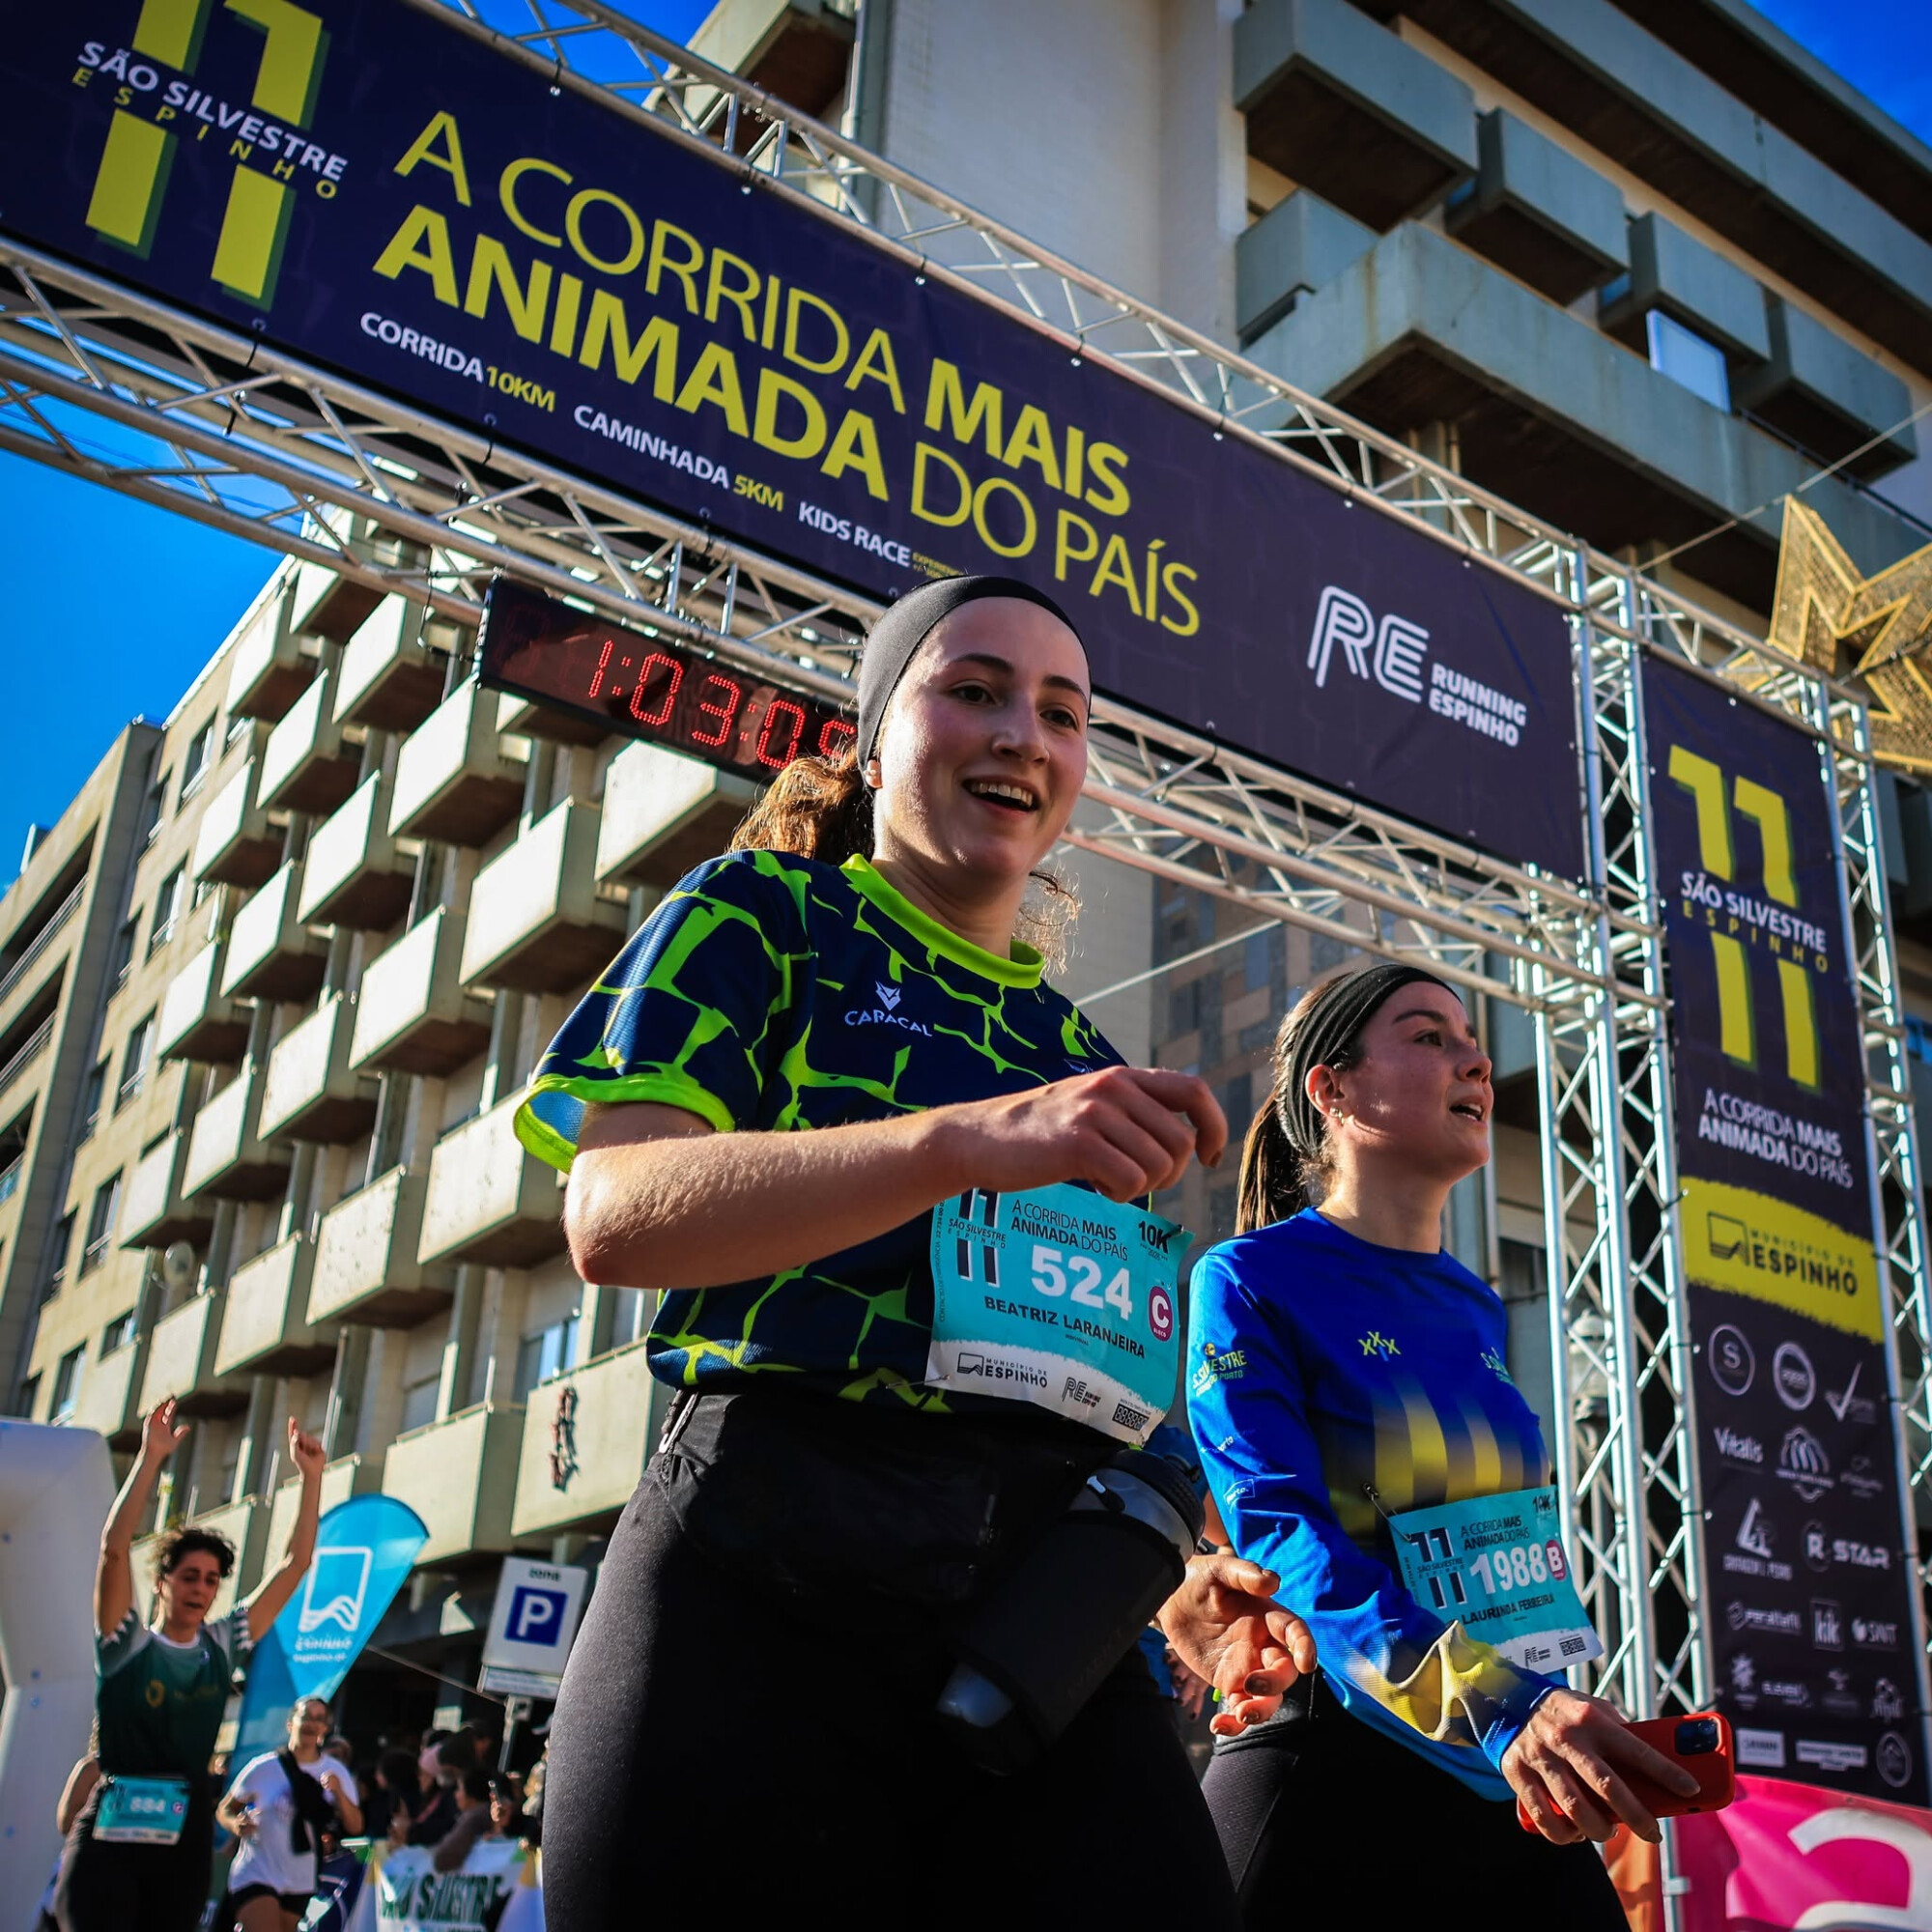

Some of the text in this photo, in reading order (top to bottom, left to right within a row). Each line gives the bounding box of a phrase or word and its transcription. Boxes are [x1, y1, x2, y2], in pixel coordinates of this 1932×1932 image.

[71, 68, 337, 199] ESPINHO
[78, 41, 348, 183] SÃO SILVESTRE
[393, 110, 1130, 516] A CORRIDA MAIS
[359, 312, 555, 413] CORRIDA 10KM
[372, 204, 1200, 637] ANIMADA DO PAÍS
[573, 405, 783, 512] CAMINHADA 5KM
[798, 501, 911, 567] KIDS RACE
[1307, 585, 1430, 703] RE
[1429, 688, 1519, 747] ESPINHO
[1431, 663, 1526, 726] RUNNING
[1681, 871, 1827, 953] SÃO SILVESTRE
[1683, 900, 1828, 973] ESPINHO
[844, 1009, 933, 1037] CARACAL
[1704, 1088, 1842, 1157] A CORRIDA MAIS
[1698, 1114, 1854, 1189] ANIMADA DO PAÍS
[948, 1217, 1006, 1242] SÃO SILVESTRE
[1010, 1216, 1079, 1247] ANIMADA
[1080, 1236, 1102, 1253] DO
[1104, 1241, 1128, 1262] PAÍS
[1011, 1200, 1117, 1240] A CORRIDA MAIS
[1138, 1220, 1170, 1254] 10K
[1031, 1244, 1133, 1321] 524
[1752, 1243, 1857, 1296] ESPINHO
[984, 1296, 1145, 1359] BEATRIZ LARANJEIRA
[1151, 1294, 1169, 1328] C
[985, 1365, 1047, 1388] ESPINHO
[986, 1358, 1034, 1372] MUNICÍPIO
[1062, 1377, 1088, 1402] RE
[1713, 1426, 1763, 1463] Vitalis
[1461, 1526, 1469, 1537] A
[1463, 1535, 1504, 1551] ANIMADA
[1470, 1543, 1548, 1595] 1988
[1546, 1546, 1563, 1572] B
[516, 1593, 554, 1637] P
[1461, 1593, 1555, 1625] LAURINDA FERREIRA
